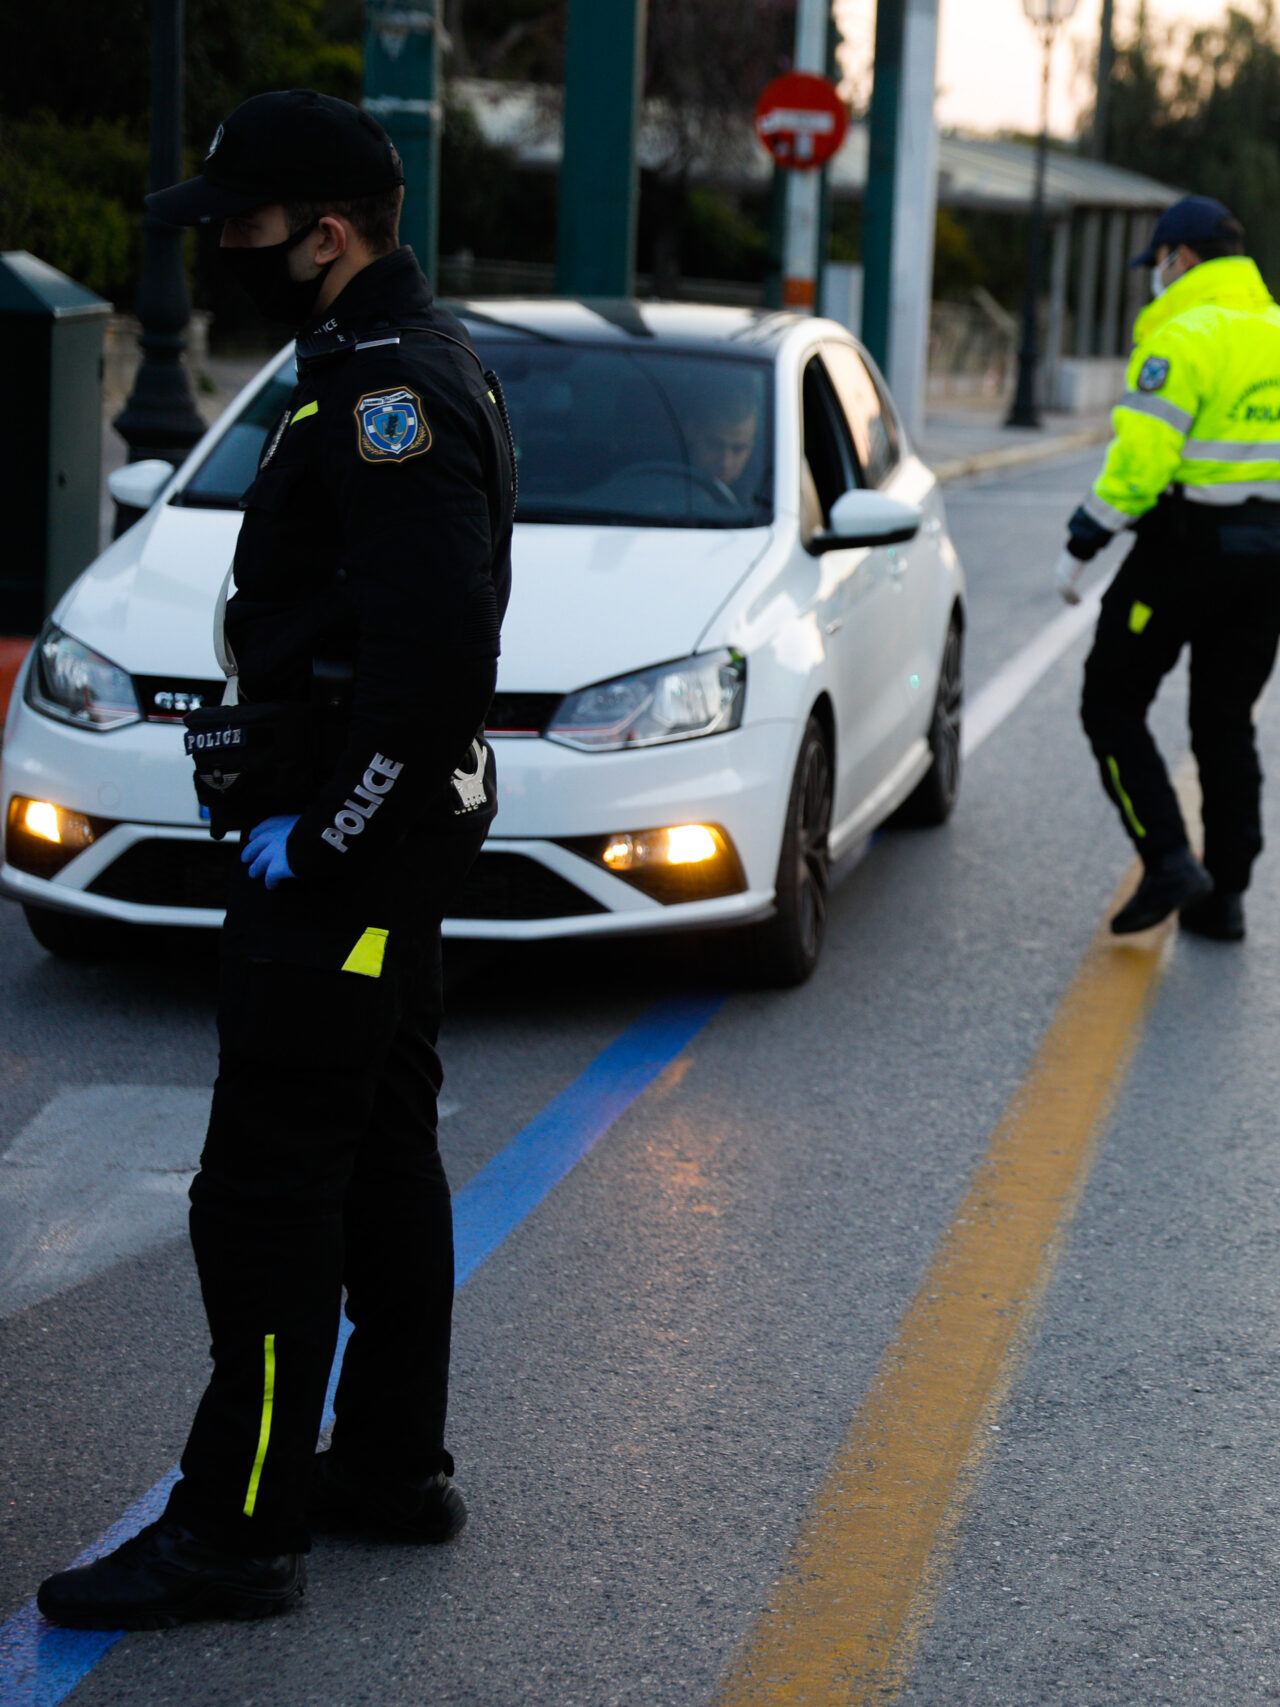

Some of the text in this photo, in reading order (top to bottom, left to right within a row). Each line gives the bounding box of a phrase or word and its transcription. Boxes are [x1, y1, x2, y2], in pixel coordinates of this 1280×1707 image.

[154, 691, 204, 711] GTI
[187, 728, 241, 750] POLICE
[321, 752, 404, 853] POLICE
